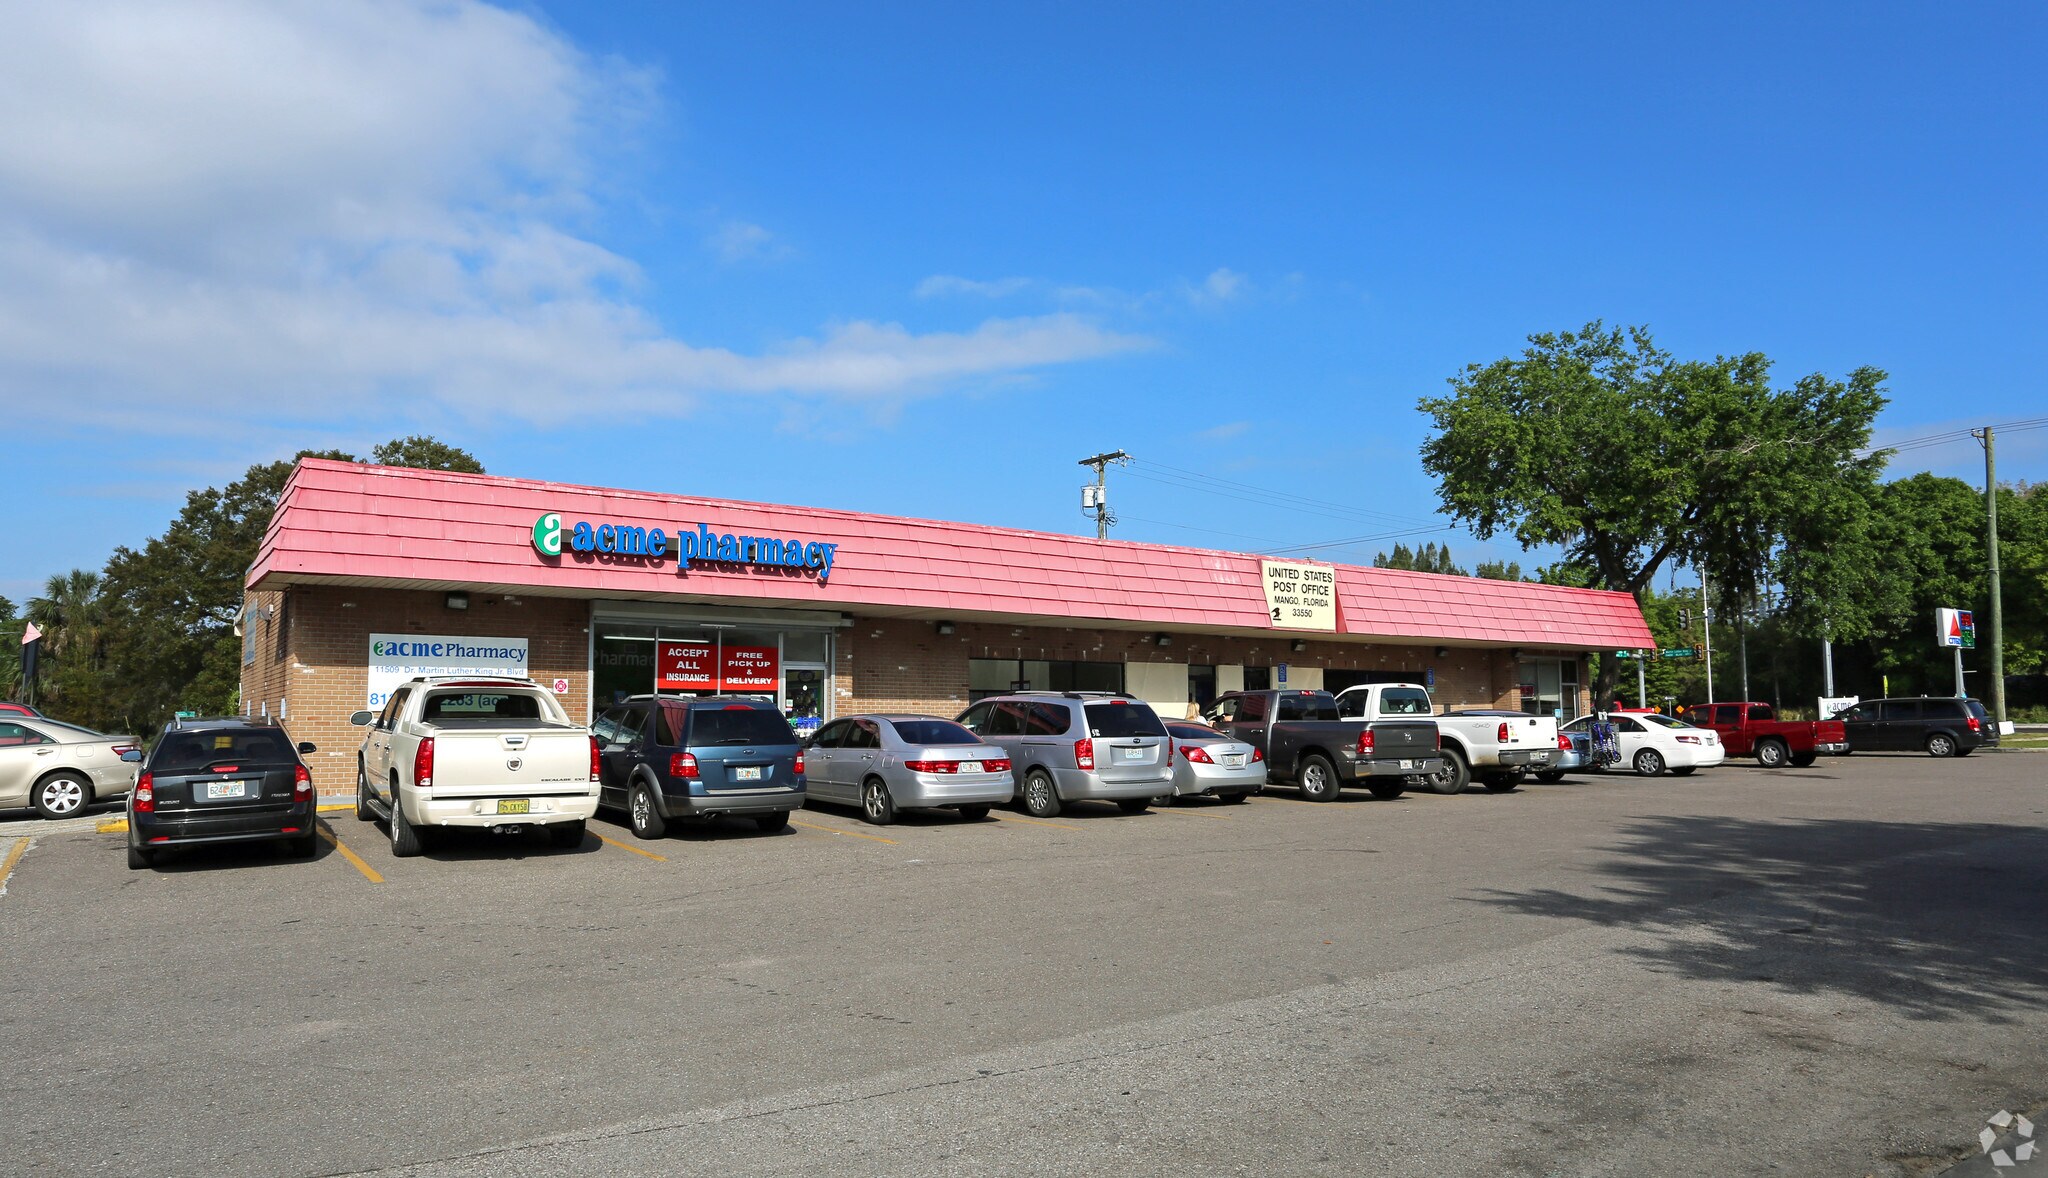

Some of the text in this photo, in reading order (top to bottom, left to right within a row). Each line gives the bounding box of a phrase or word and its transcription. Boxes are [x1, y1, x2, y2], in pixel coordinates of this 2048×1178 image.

[571, 521, 667, 557] acme
[677, 523, 839, 579] pharmacy
[1268, 567, 1333, 583] UNITED STATES
[1273, 581, 1329, 596] POST OFFICE
[1303, 597, 1329, 607] FLORIDA
[1292, 608, 1313, 618] 33550
[384, 641, 443, 657] acme
[446, 643, 527, 662] Pharmacy
[668, 648, 709, 658] ACCEPT
[375, 665, 524, 677] 11509 Dr. Martin Luther King Jr. Blvd
[676, 661, 700, 670] ALL
[666, 673, 710, 682] INSURANCE
[726, 677, 773, 685] DELIVERY
[370, 692, 393, 705] 81
